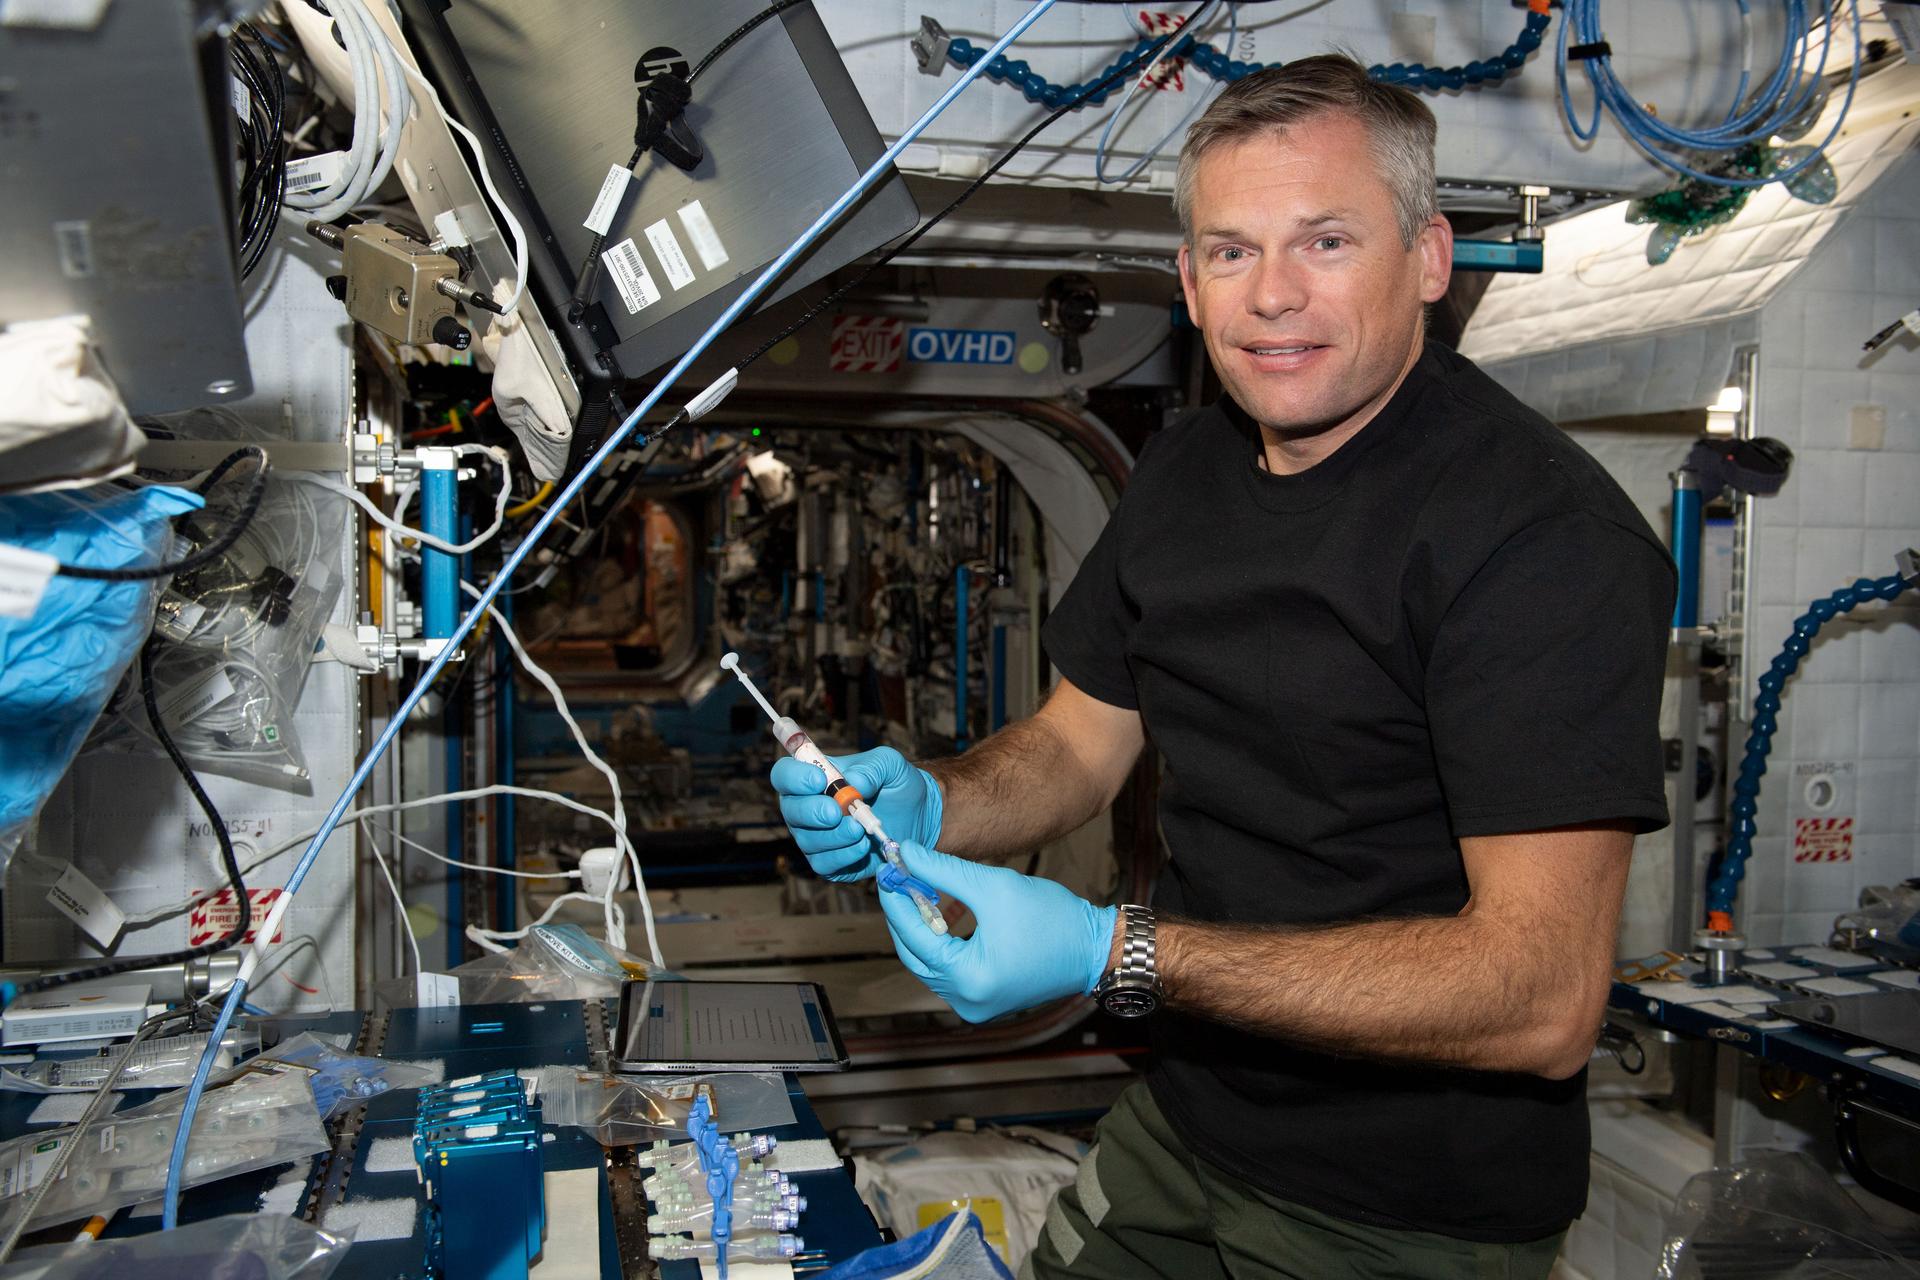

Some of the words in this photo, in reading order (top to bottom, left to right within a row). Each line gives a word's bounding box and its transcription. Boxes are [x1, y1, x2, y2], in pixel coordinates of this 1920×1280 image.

[625, 295, 636, 312] ZBook
[843, 329, 889, 358] EXIT
[911, 331, 1013, 362] OVHD
[209, 915, 231, 924] FIRE
[537, 928, 560, 950] REMOVE
[562, 946, 572, 958] KIT
[571, 956, 591, 970] FROM
